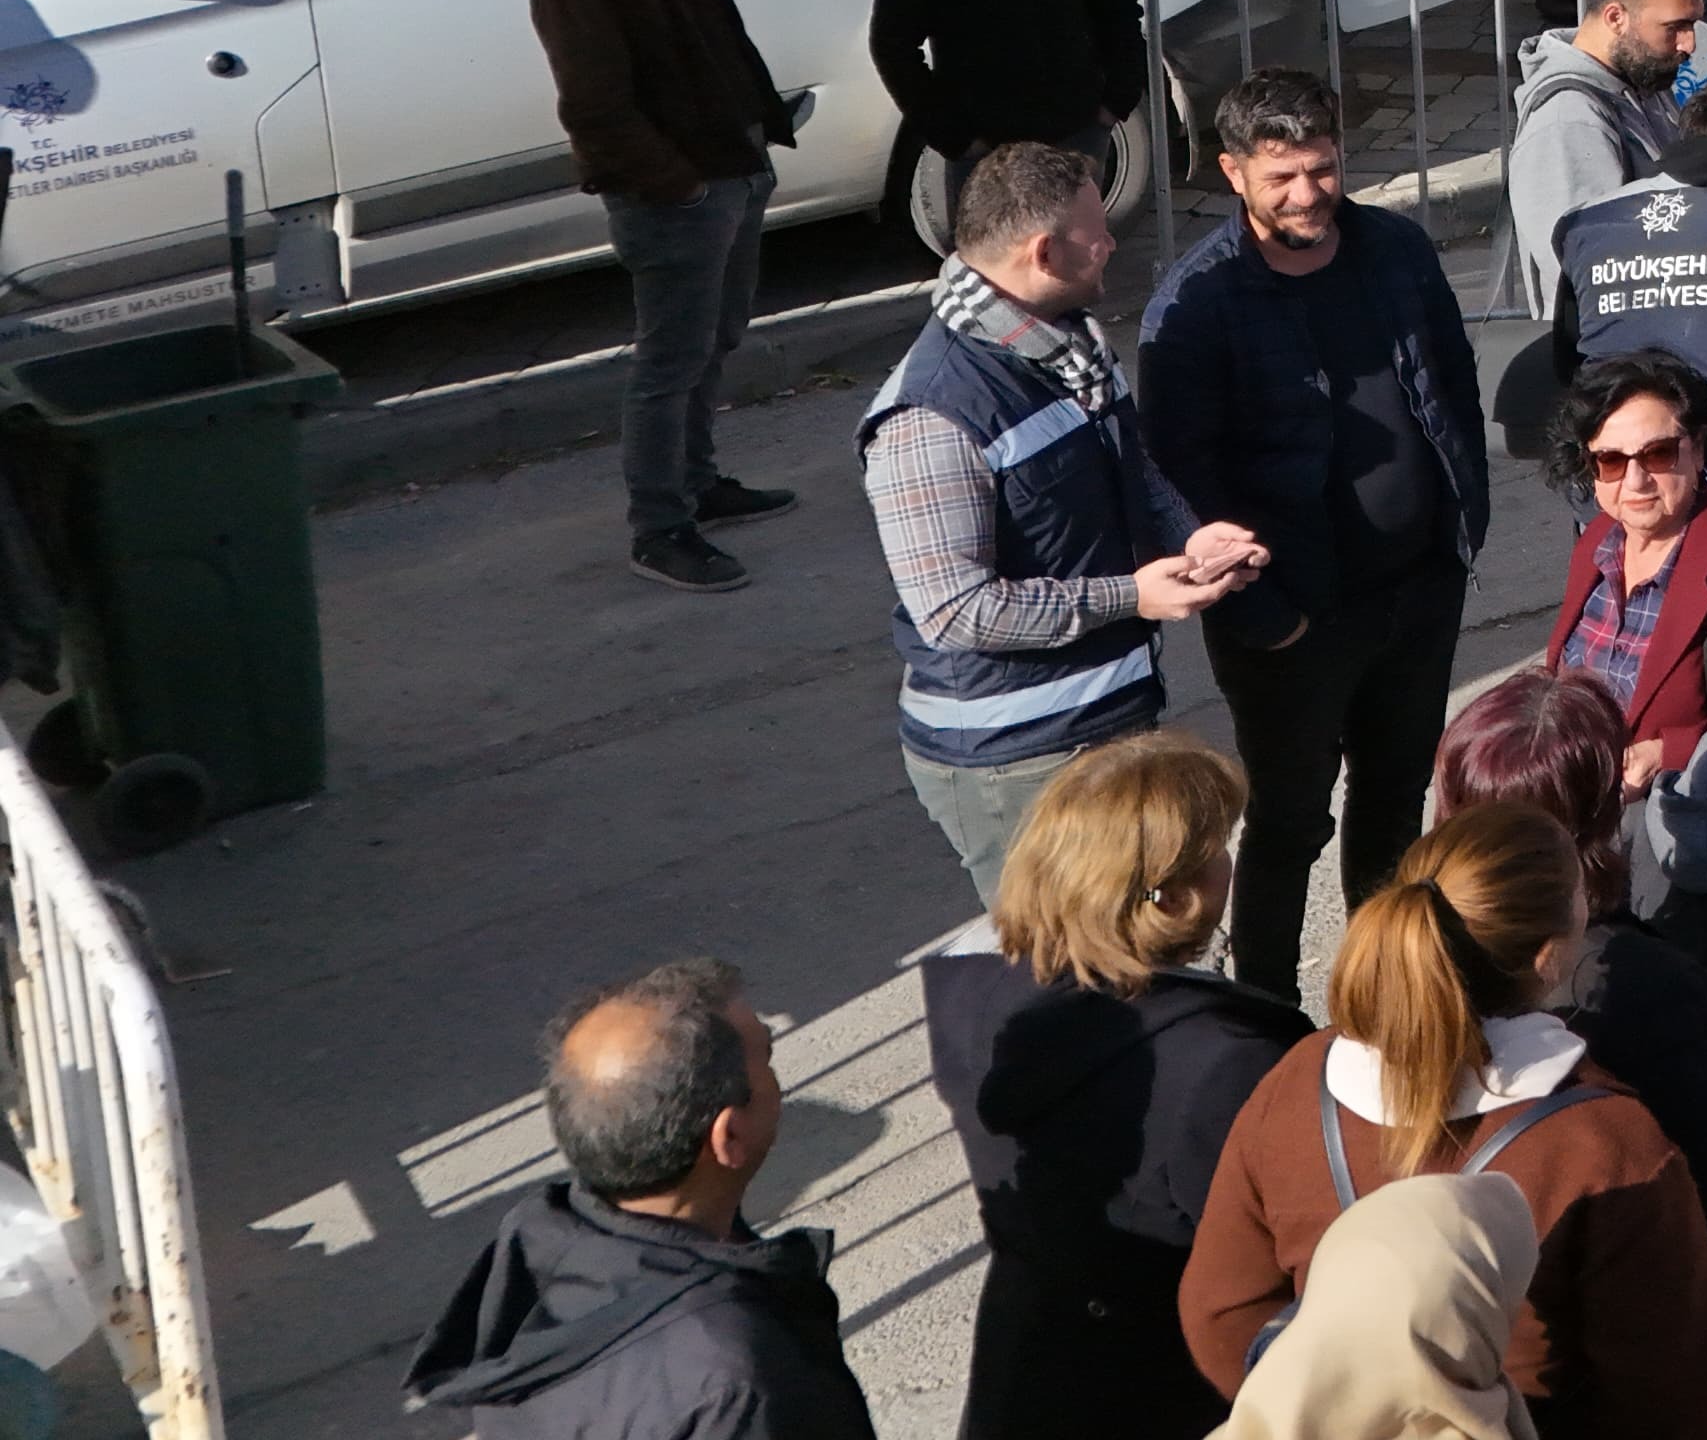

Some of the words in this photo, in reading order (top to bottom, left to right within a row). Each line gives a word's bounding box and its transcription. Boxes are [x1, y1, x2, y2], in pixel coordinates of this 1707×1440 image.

[8, 178, 51, 201] ETLER
[53, 167, 111, 191] DAİRESİ
[113, 148, 199, 179] BAŞKANLIĞI
[12, 143, 99, 175] KŞEHİR
[103, 127, 196, 158] BELEDİYESİ
